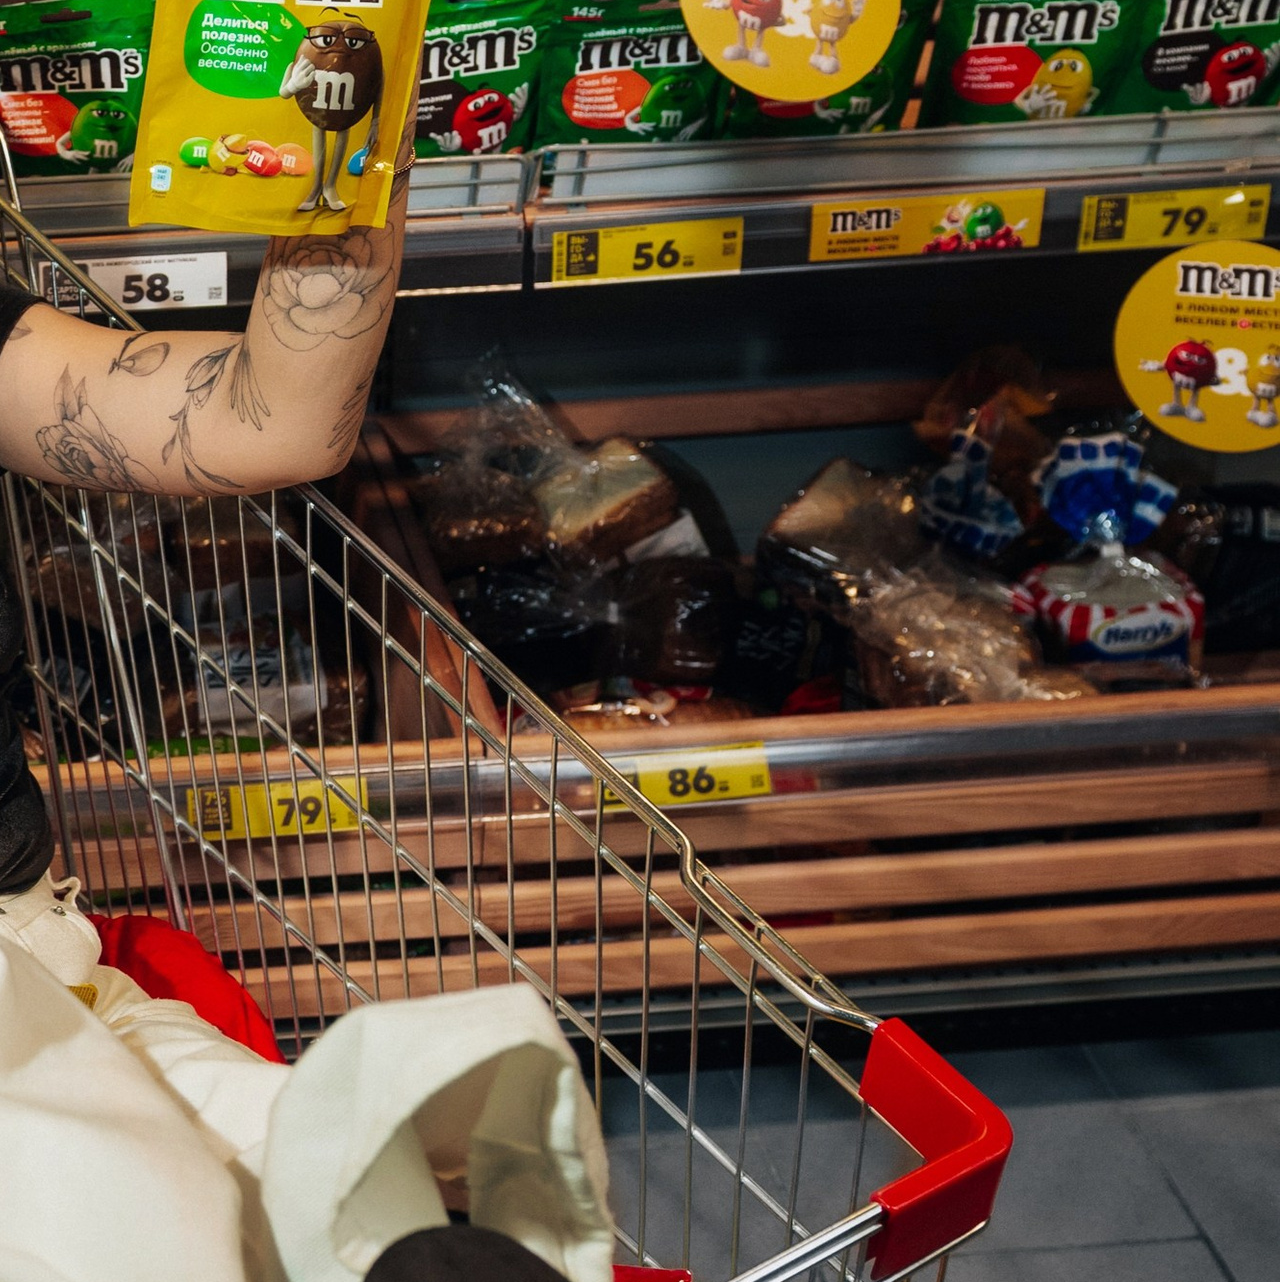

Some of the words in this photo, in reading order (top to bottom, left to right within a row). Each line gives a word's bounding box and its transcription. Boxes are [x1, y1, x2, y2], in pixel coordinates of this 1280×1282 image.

[202, 12, 269, 33] Делиться
[572, 6, 605, 18] 145г
[970, 0, 1118, 46] m&m's
[200, 41, 269, 59] Особенно
[201, 29, 265, 45] полезно.
[197, 57, 268, 74] весельем!
[829, 207, 902, 233] m&m's
[1161, 207, 1208, 237] 79
[632, 239, 680, 271] 56
[122, 272, 170, 304] 58
[667, 765, 716, 798] 86
[277, 795, 323, 826] 79
